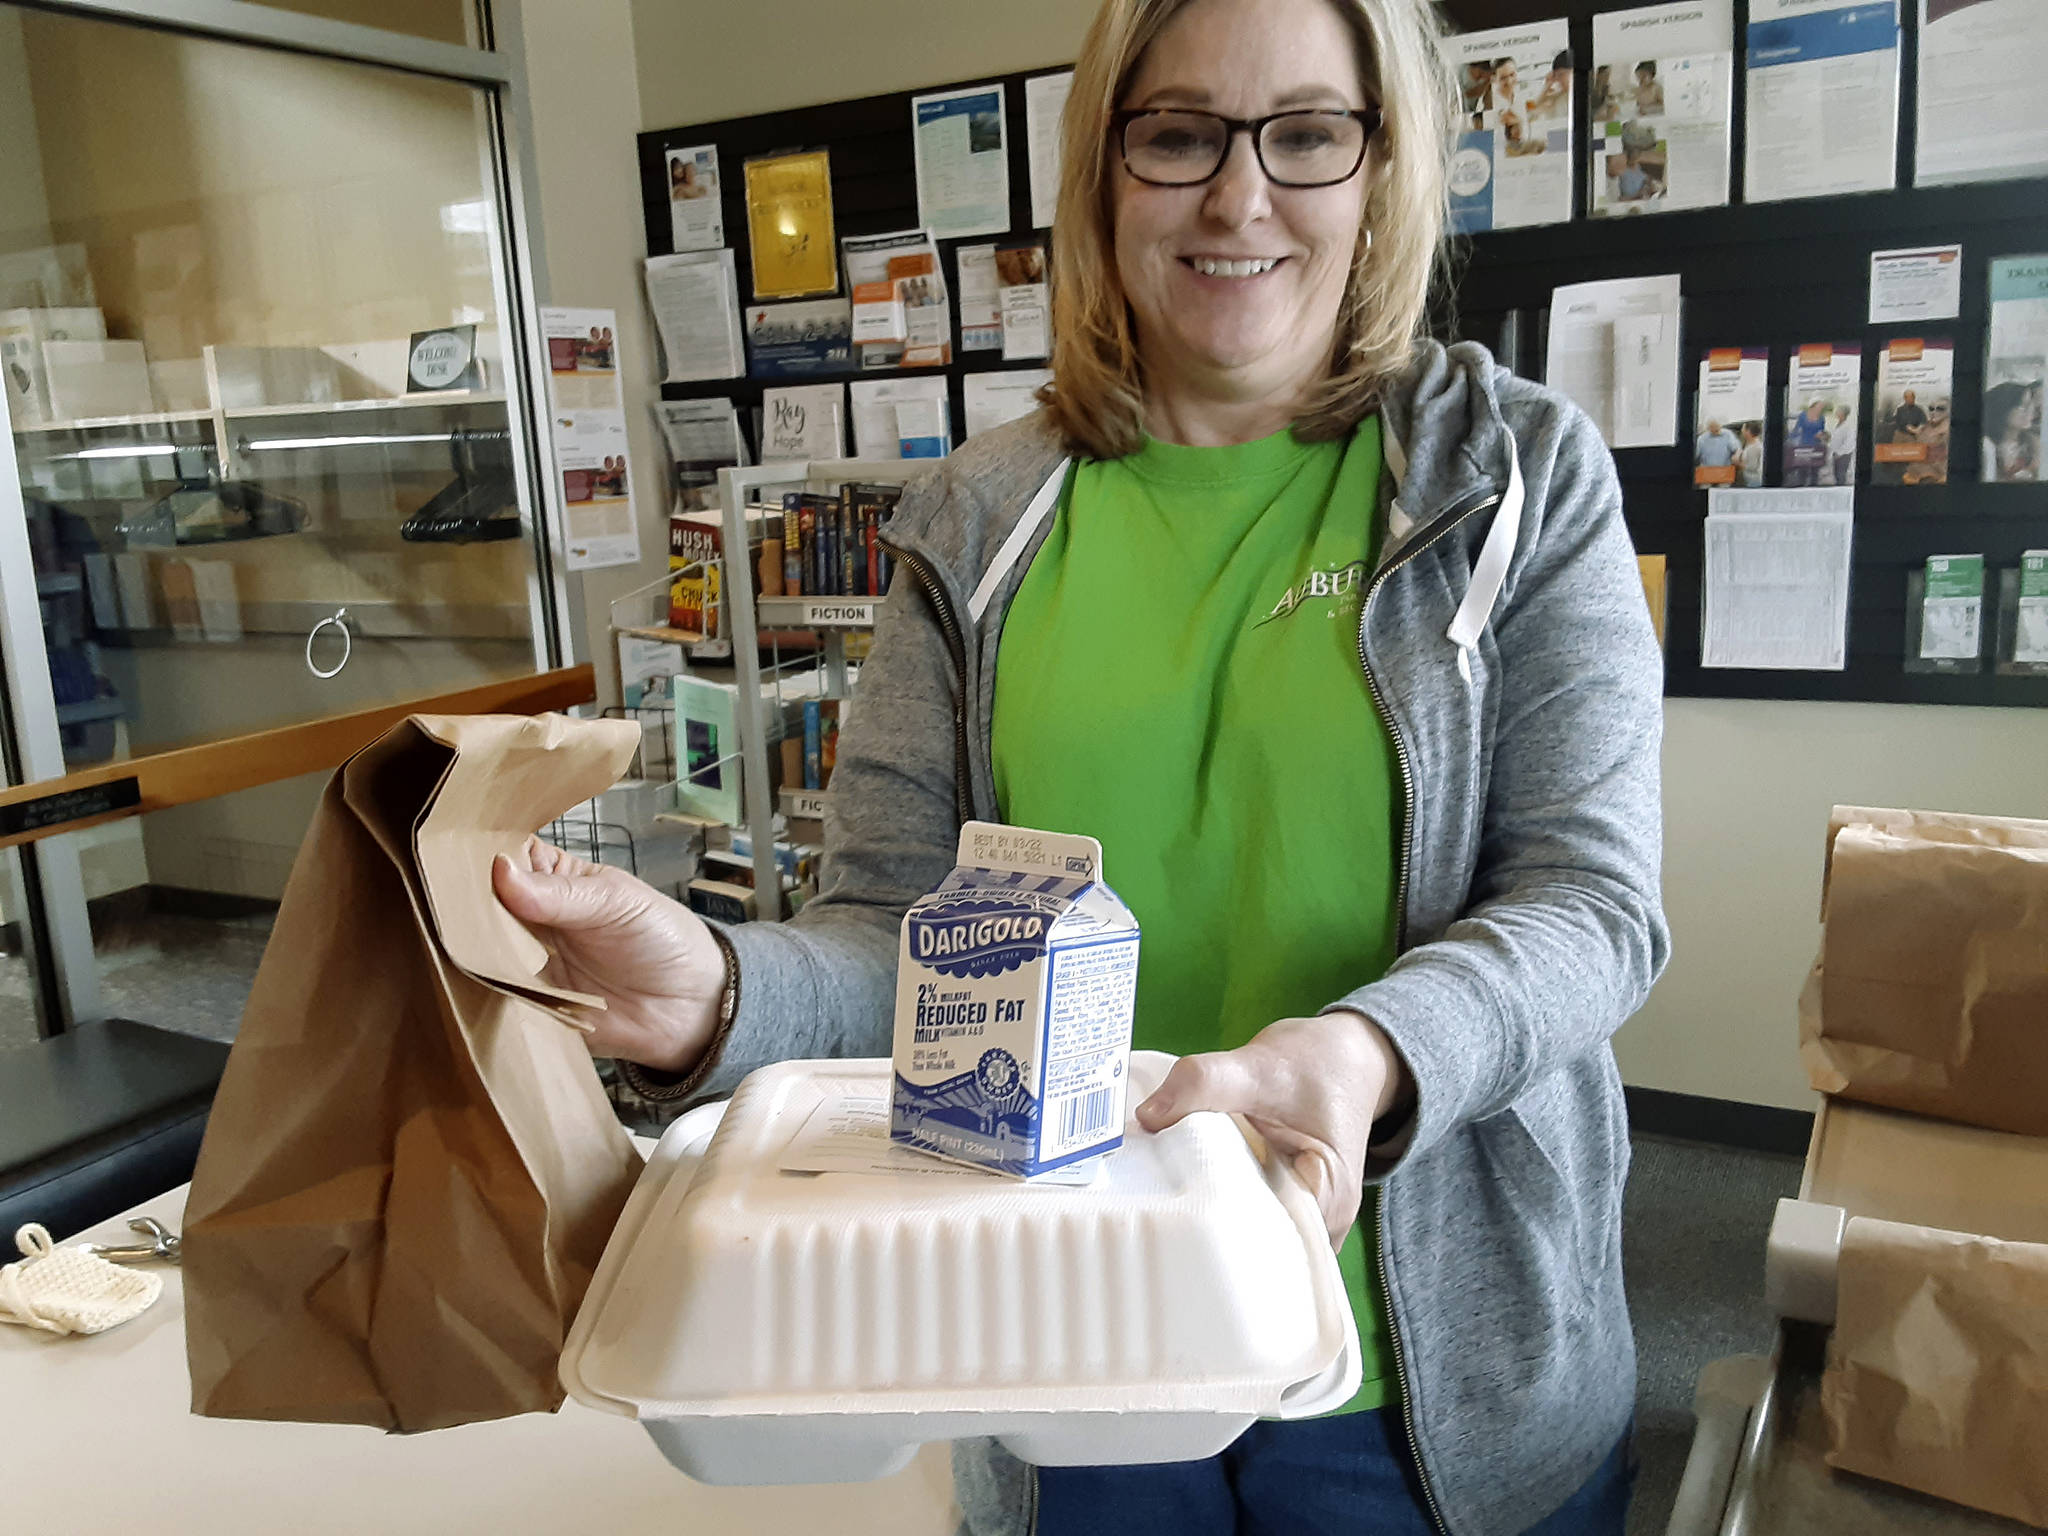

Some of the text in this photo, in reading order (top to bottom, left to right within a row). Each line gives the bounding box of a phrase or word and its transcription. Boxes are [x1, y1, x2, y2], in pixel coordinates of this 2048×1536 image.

[1620, 10, 1703, 31] SPANISH VERSION
[1463, 34, 1540, 53] SPANISH VERSION
[773, 397, 806, 434] Ray
[773, 434, 804, 450] Hope
[672, 528, 714, 551] HUSH
[810, 607, 866, 620] FICTION
[973, 833, 993, 847] BEST
[919, 916, 1043, 957] DARIGOLD
[917, 982, 938, 1004] 2%
[915, 998, 1026, 1027] REDUCED FAT
[913, 1026, 941, 1044] MILK
